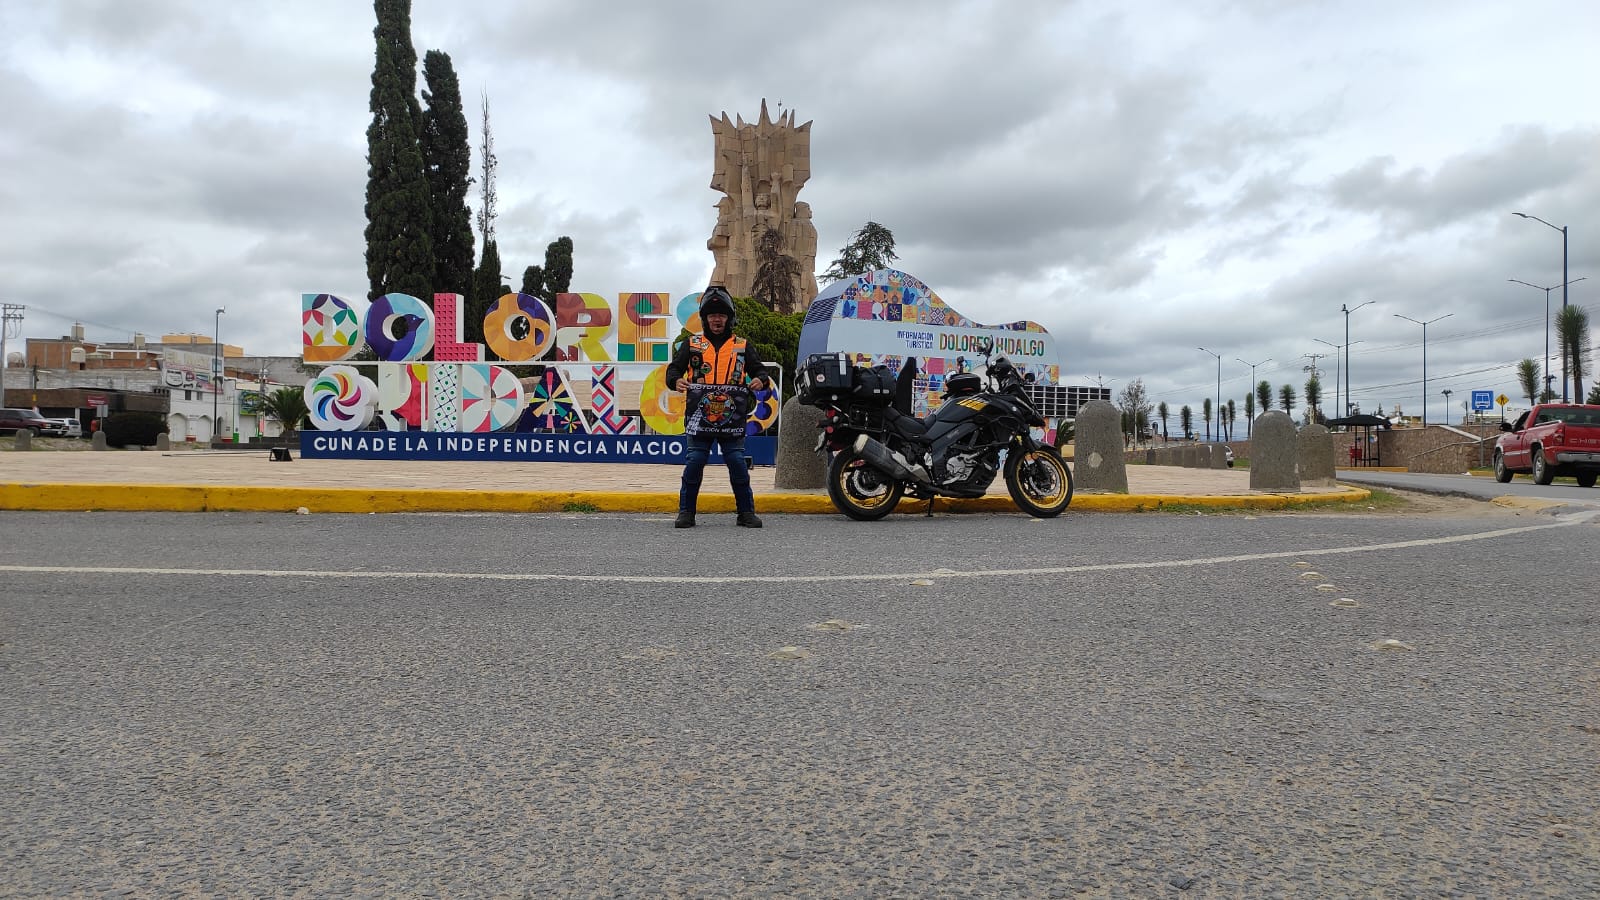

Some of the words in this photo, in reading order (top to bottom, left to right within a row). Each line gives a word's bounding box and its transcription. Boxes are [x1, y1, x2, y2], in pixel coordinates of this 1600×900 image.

[996, 336, 1045, 357] HIDALGO
[405, 437, 428, 451] LA
[437, 437, 608, 455] INDEPENDENCIA
